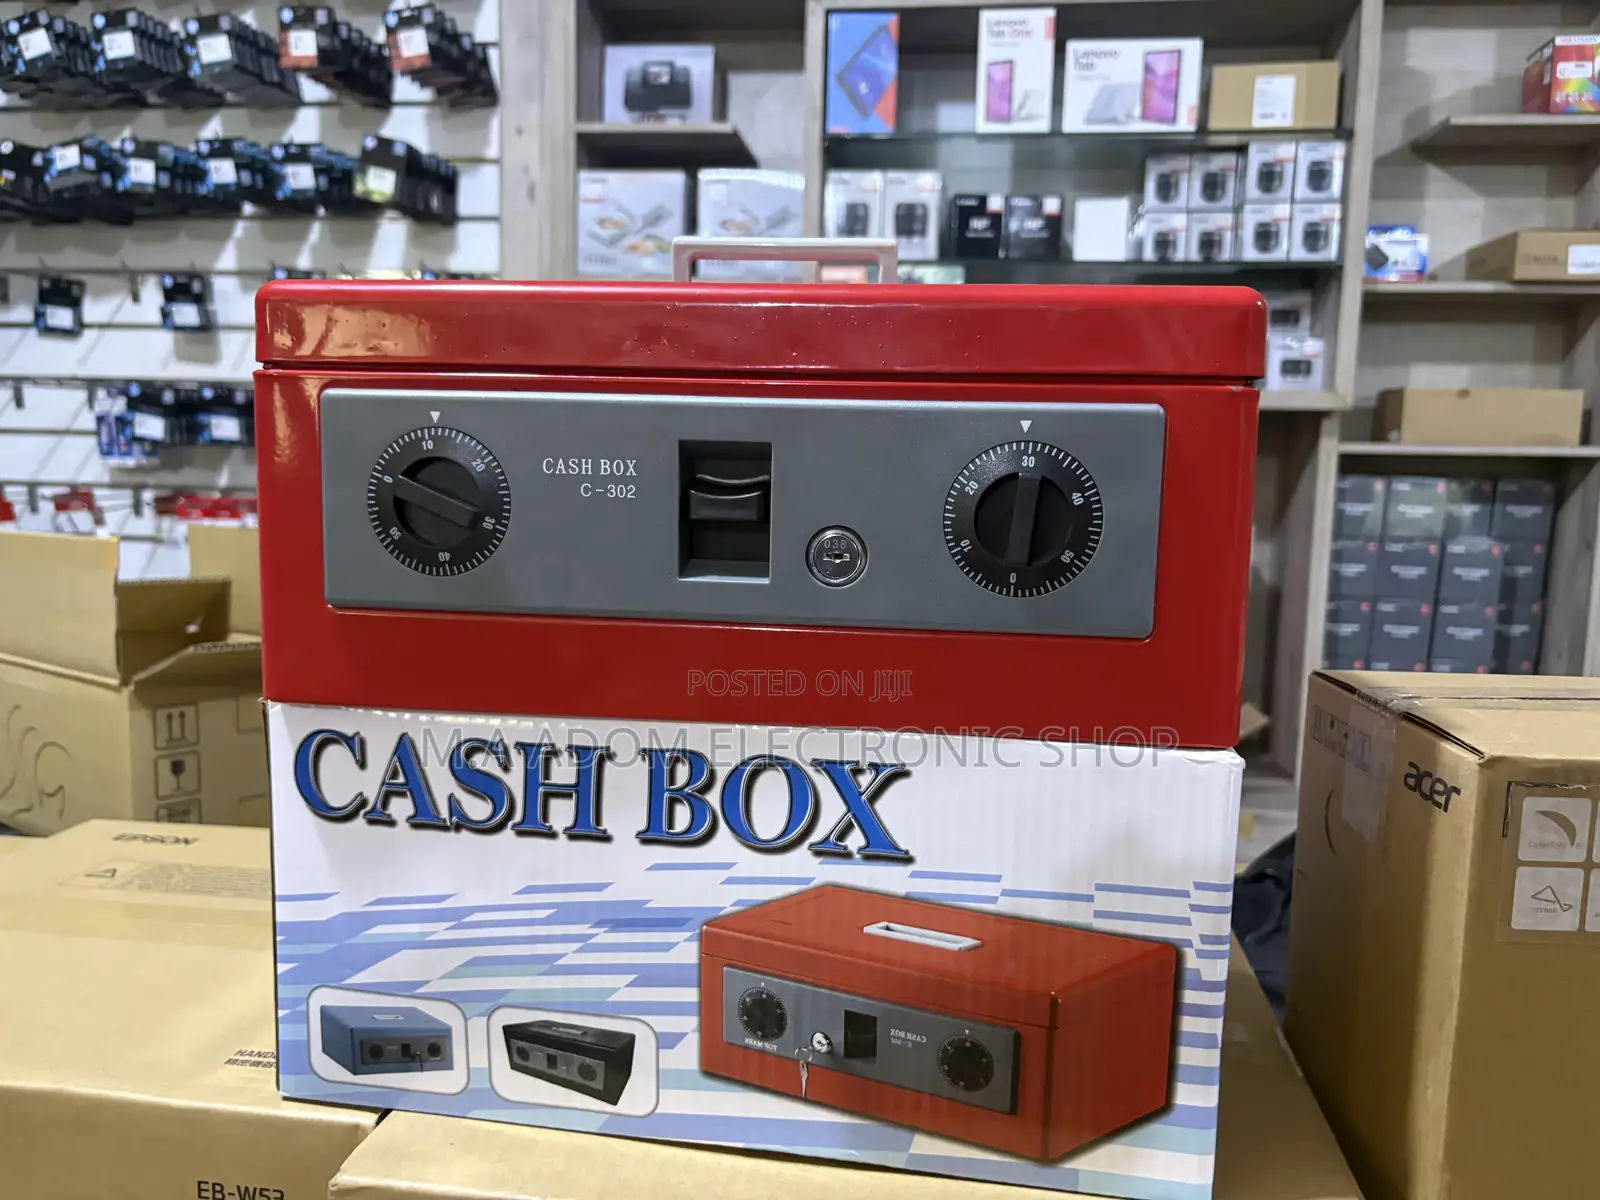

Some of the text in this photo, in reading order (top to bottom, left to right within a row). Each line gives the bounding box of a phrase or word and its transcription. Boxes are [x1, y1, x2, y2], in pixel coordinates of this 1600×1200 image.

[421, 439, 434, 451] 10
[471, 457, 485, 473] 20
[542, 458, 638, 476] CASH BOX
[1021, 455, 1036, 468] 30
[580, 483, 636, 499] C-302
[965, 480, 979, 496] 20
[1071, 491, 1084, 506] 40
[483, 515, 496, 530] 30
[389, 526, 402, 540] 50
[960, 539, 973, 553] 10
[438, 551, 451, 563] 40
[1061, 549, 1075, 564] 50
[1010, 573, 1017, 584] 0
[1403, 761, 1461, 813] acer
[293, 728, 912, 863] CASH BOX
